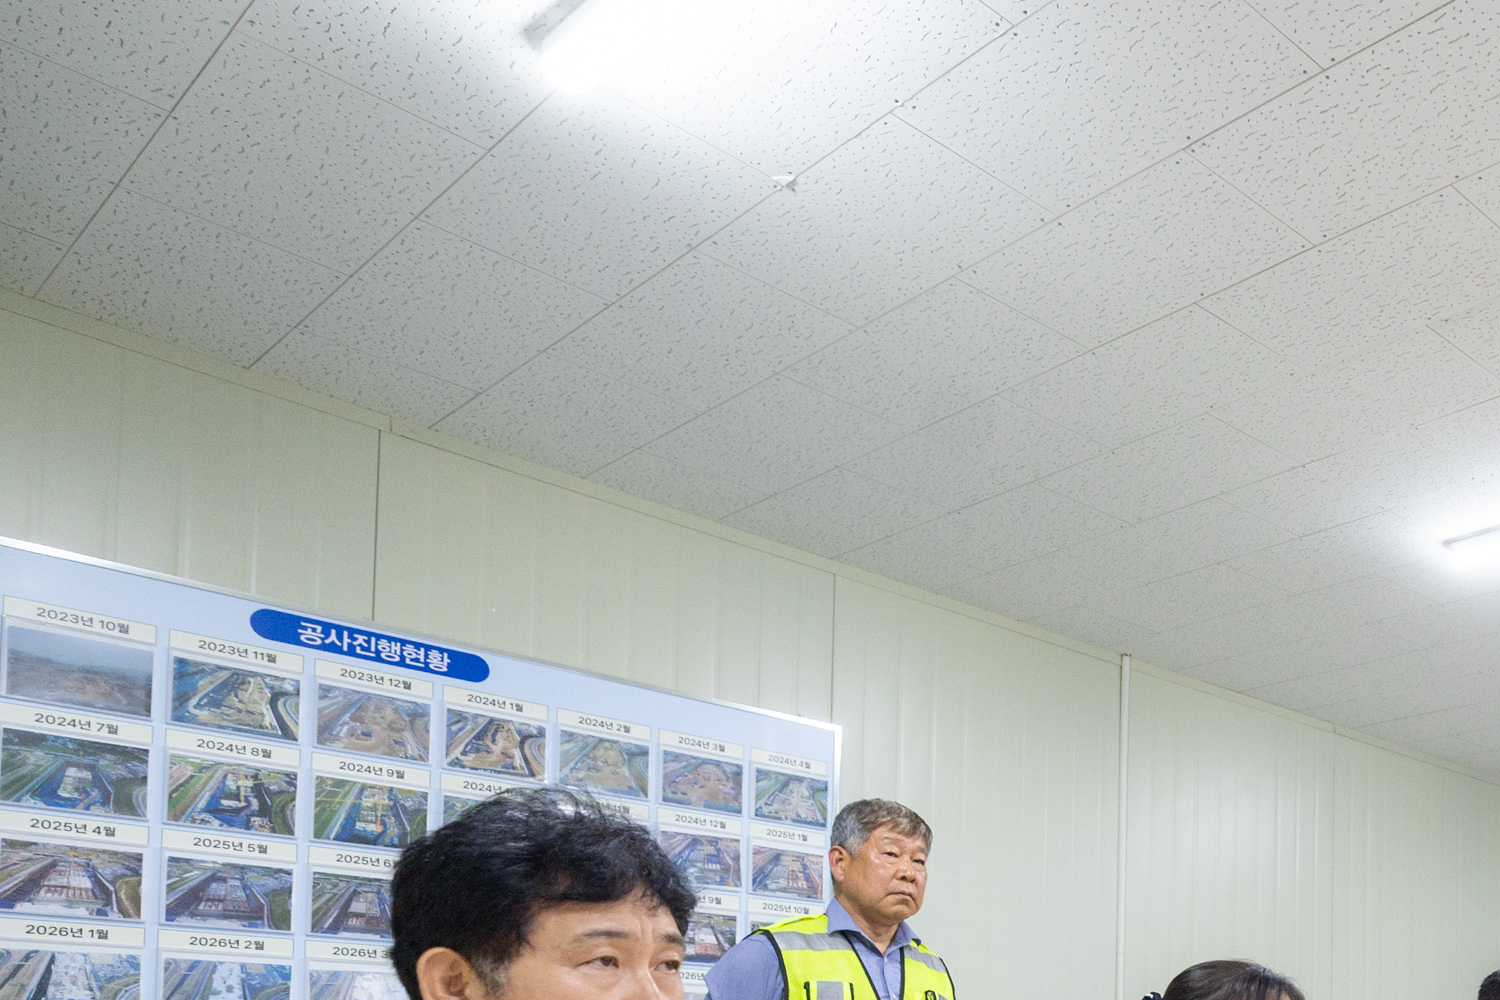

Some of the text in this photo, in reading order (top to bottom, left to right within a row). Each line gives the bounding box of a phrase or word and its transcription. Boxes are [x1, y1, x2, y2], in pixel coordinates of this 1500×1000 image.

[36, 606, 130, 636] 2023년 10월
[197, 639, 277, 664] 2023년 11월
[297, 621, 451, 673] 공사진행현황
[340, 667, 412, 691] 2023년 12월
[467, 693, 524, 713] 2024년 1월
[34, 712, 119, 735] 2024년 7월
[578, 715, 631, 734] 2024년 2월
[196, 738, 272, 759] 2024년 8월
[678, 736, 726, 753] 2024년 3월
[338, 761, 405, 780] 2024년 9월
[767, 754, 811, 770] 2024년 4월
[29, 818, 117, 838] 2025년 4월
[675, 814, 727, 830] 2024년 12월
[766, 828, 808, 842] 2025년 1월
[192, 837, 268, 854] 2025년 5월
[335, 853, 396, 868] 2025년 6
[708, 896, 722, 906] 9월
[762, 902, 809, 915] 2025년 10월
[25, 924, 109, 940] 2026년 1월
[189, 935, 265, 951] 2026년 2월
[332, 946, 377, 959] 2026년
